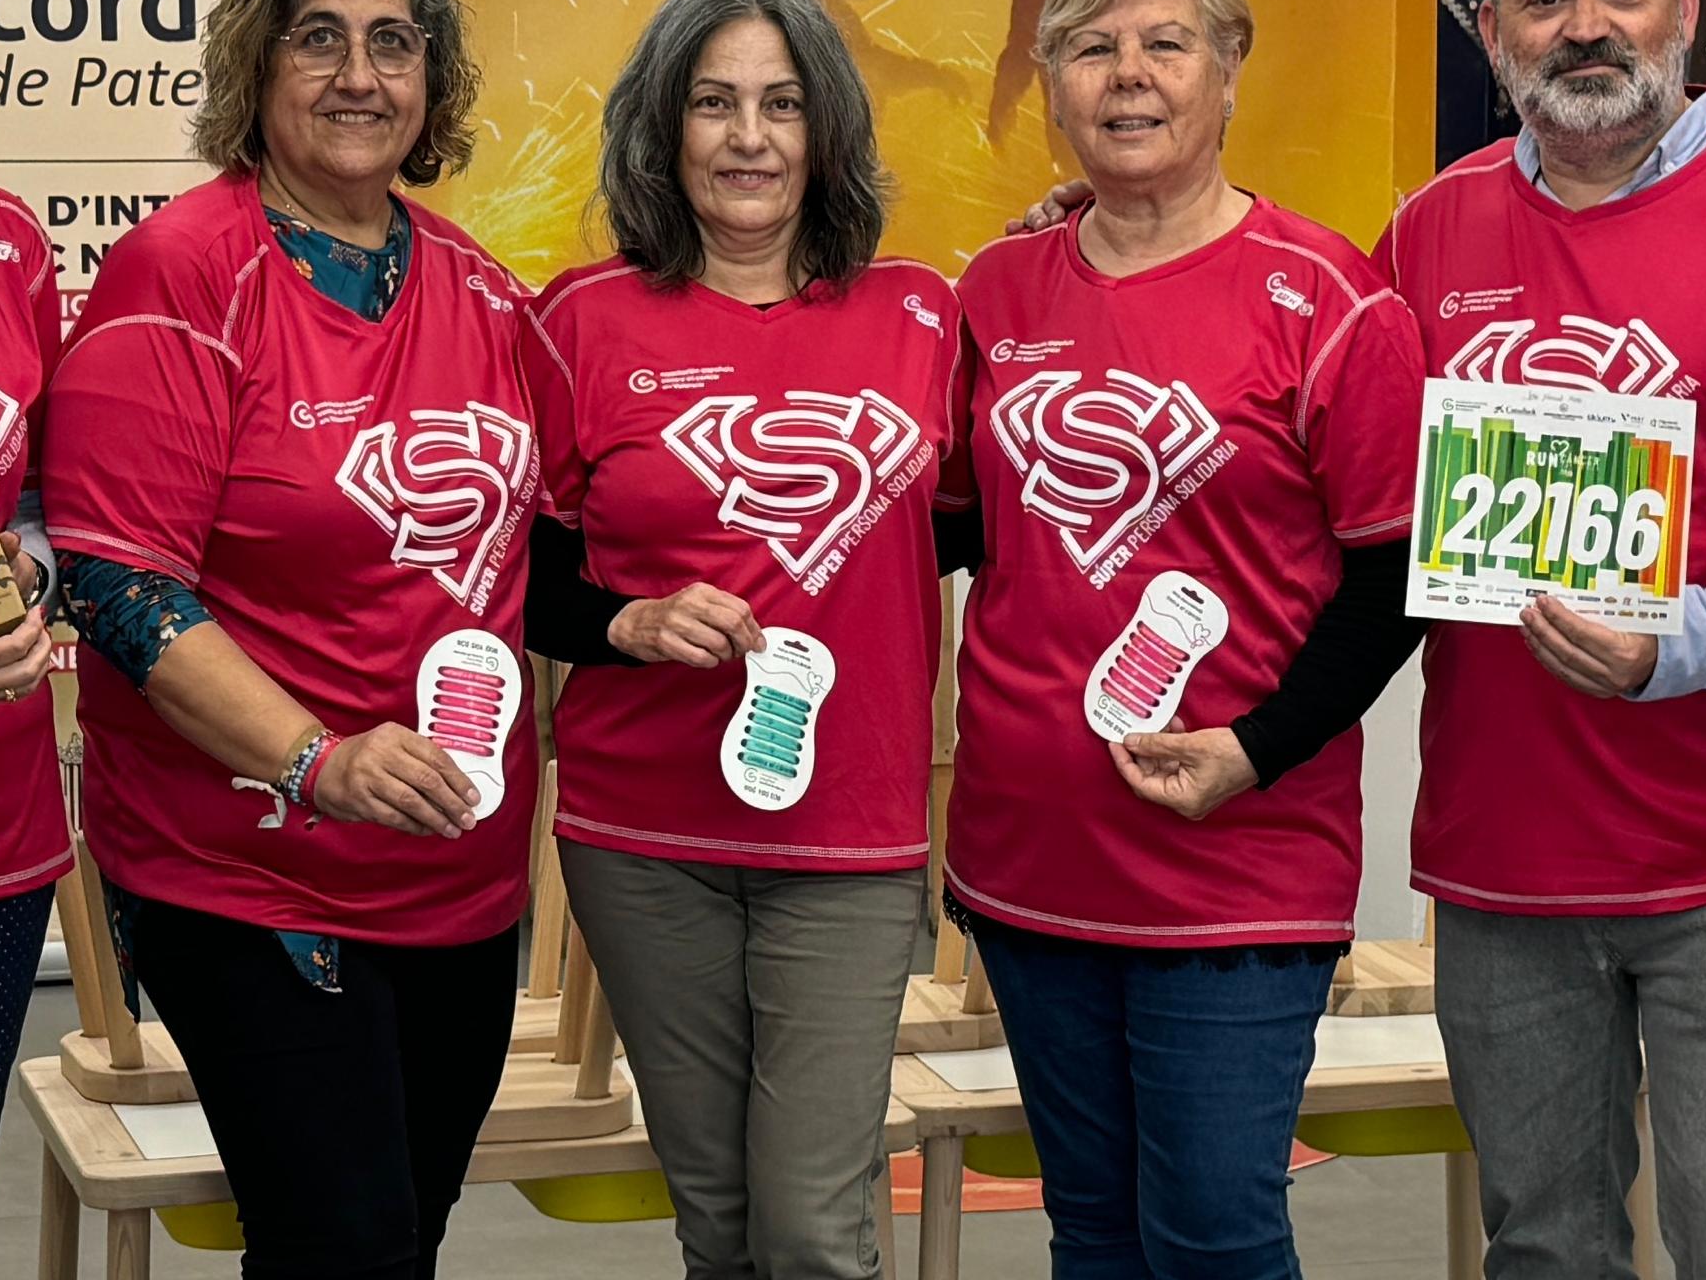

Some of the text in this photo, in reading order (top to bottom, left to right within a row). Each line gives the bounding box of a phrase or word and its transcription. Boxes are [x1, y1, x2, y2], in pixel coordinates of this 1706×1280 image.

[72, 56, 205, 108] Pate
[48, 195, 174, 227] D'INT
[1526, 450, 1559, 469] RUN
[490, 504, 525, 568] PERSONA
[520, 435, 541, 504] SOLIDAR
[838, 493, 893, 554] PERSONA
[1126, 493, 1181, 551] PERSONA
[1174, 439, 1239, 500] SOLIDARIA
[1440, 473, 1667, 571] 22166
